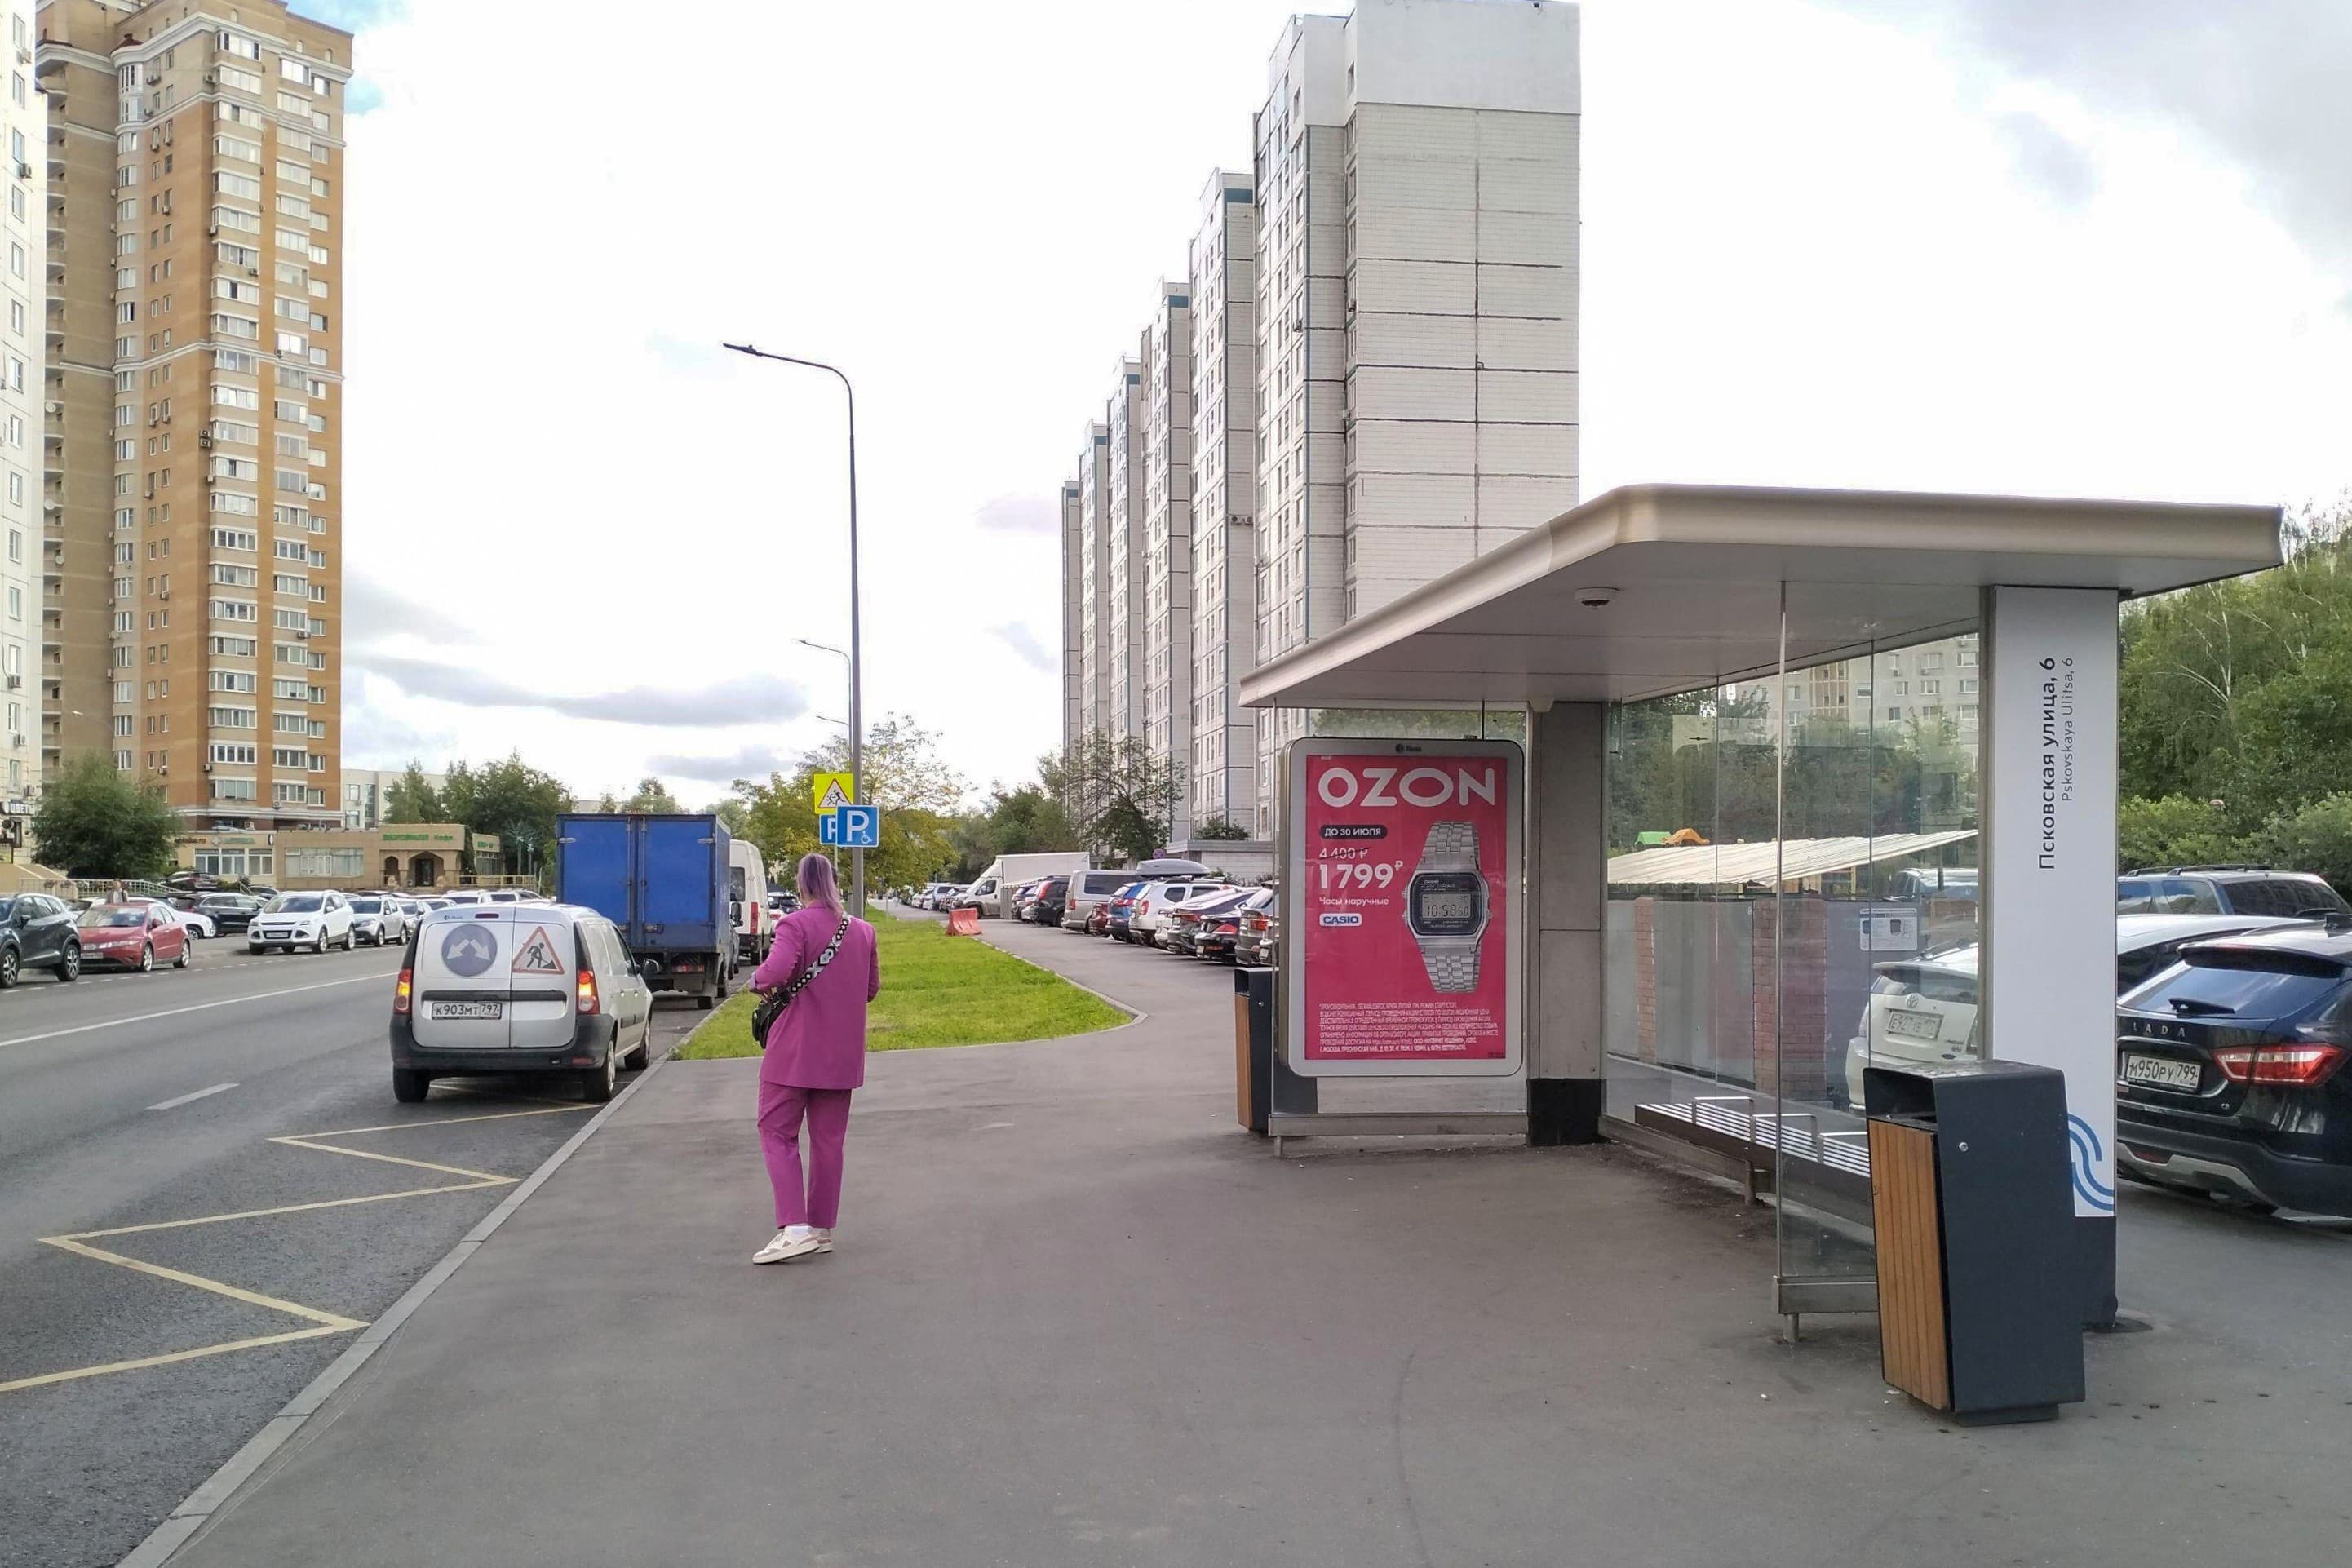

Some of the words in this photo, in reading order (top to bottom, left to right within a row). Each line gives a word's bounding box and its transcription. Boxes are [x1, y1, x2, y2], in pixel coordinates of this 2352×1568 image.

[2039, 657, 2056, 671] 6
[2062, 657, 2073, 667] 6
[2062, 671, 2075, 715] Ulitsa,
[2042, 676, 2059, 747] улица,
[2062, 720, 2075, 801] Pskovskaya
[1318, 767, 1495, 808] OZON
[2039, 754, 2055, 870] Псковская
[847, 810, 869, 842] P
[1325, 828, 1338, 837] ДО
[1340, 828, 1350, 836] 30
[1353, 828, 1381, 836] ИЮЛЯ
[1319, 897, 1342, 905] Часы
[1344, 898, 1389, 906] наручные
[436, 1004, 479, 1016] К903МТ
[481, 1004, 498, 1012] 797
[2133, 1021, 2186, 1038] LADA
[2131, 1059, 2175, 1082] М950РУ
[2177, 1063, 2197, 1080] 799
